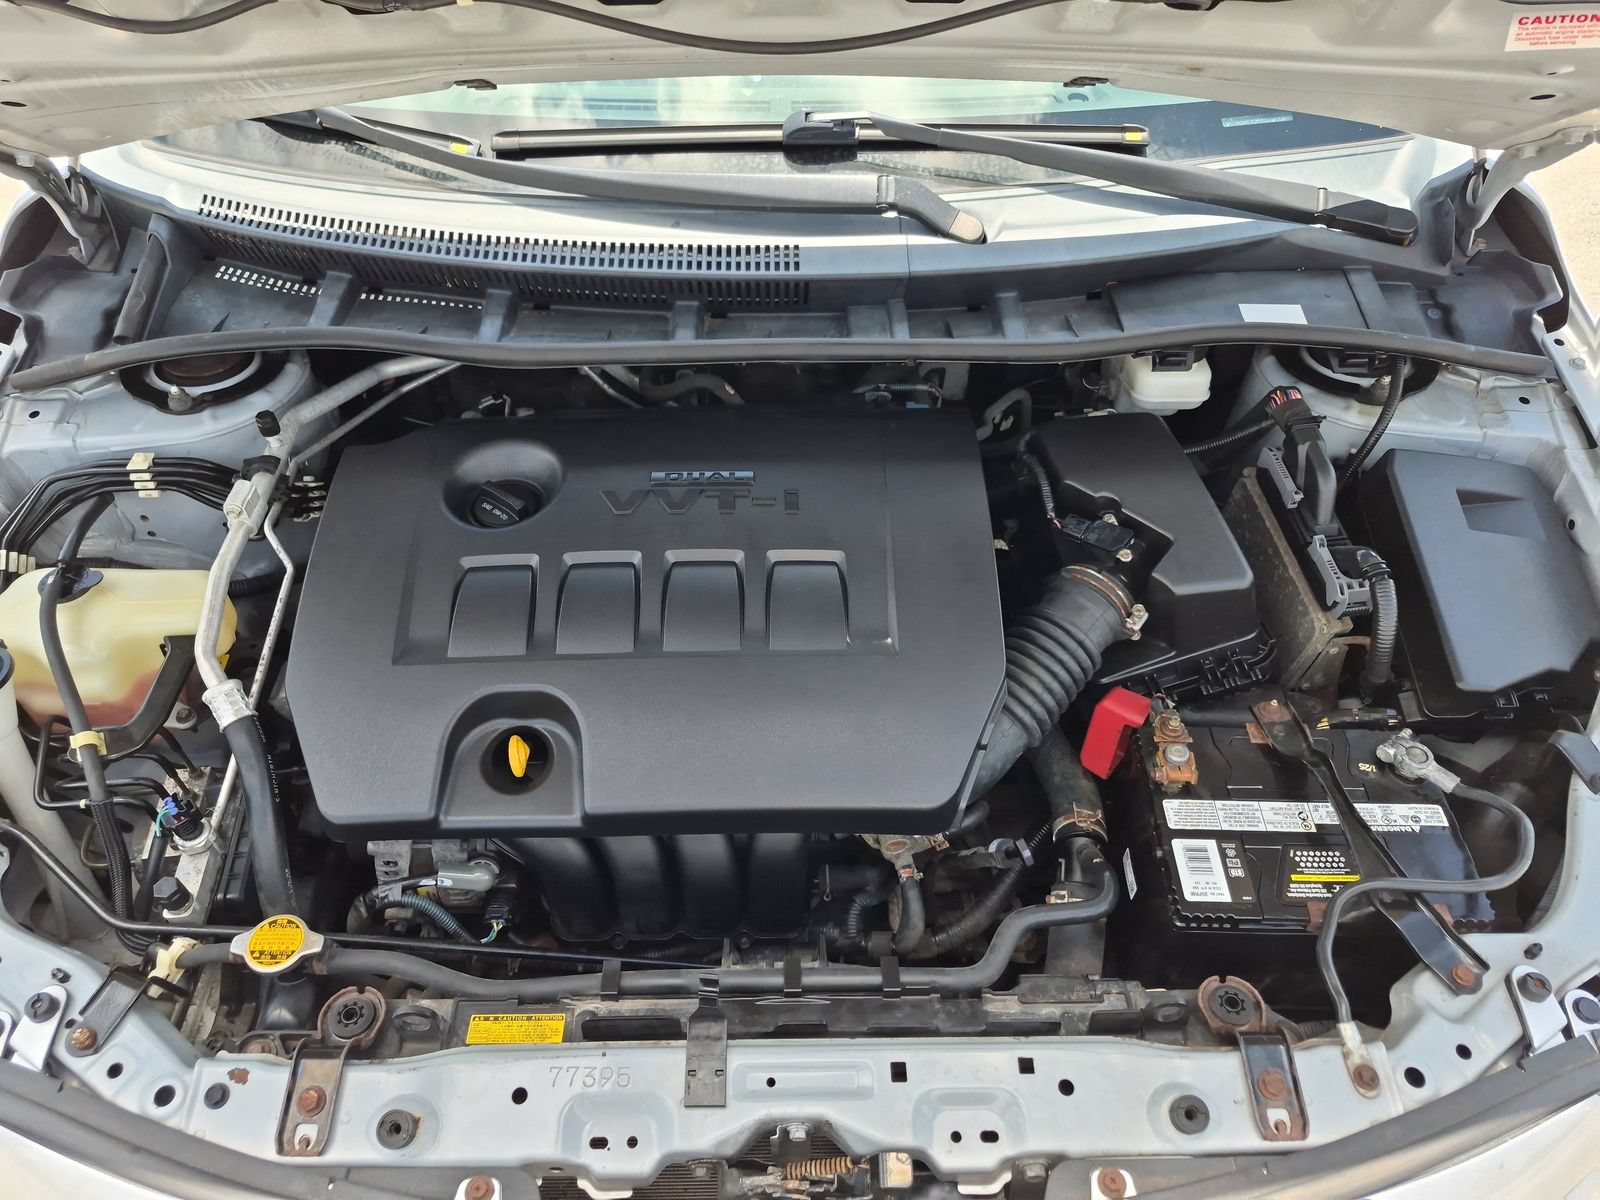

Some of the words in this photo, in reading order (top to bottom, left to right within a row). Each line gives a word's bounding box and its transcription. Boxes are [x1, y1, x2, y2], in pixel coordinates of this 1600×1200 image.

[1518, 14, 1600, 26] CAUTION
[665, 471, 746, 481] DUAL
[481, 502, 494, 511] SAE
[1358, 762, 1377, 773] 1/25
[549, 1066, 631, 1088] 77395
